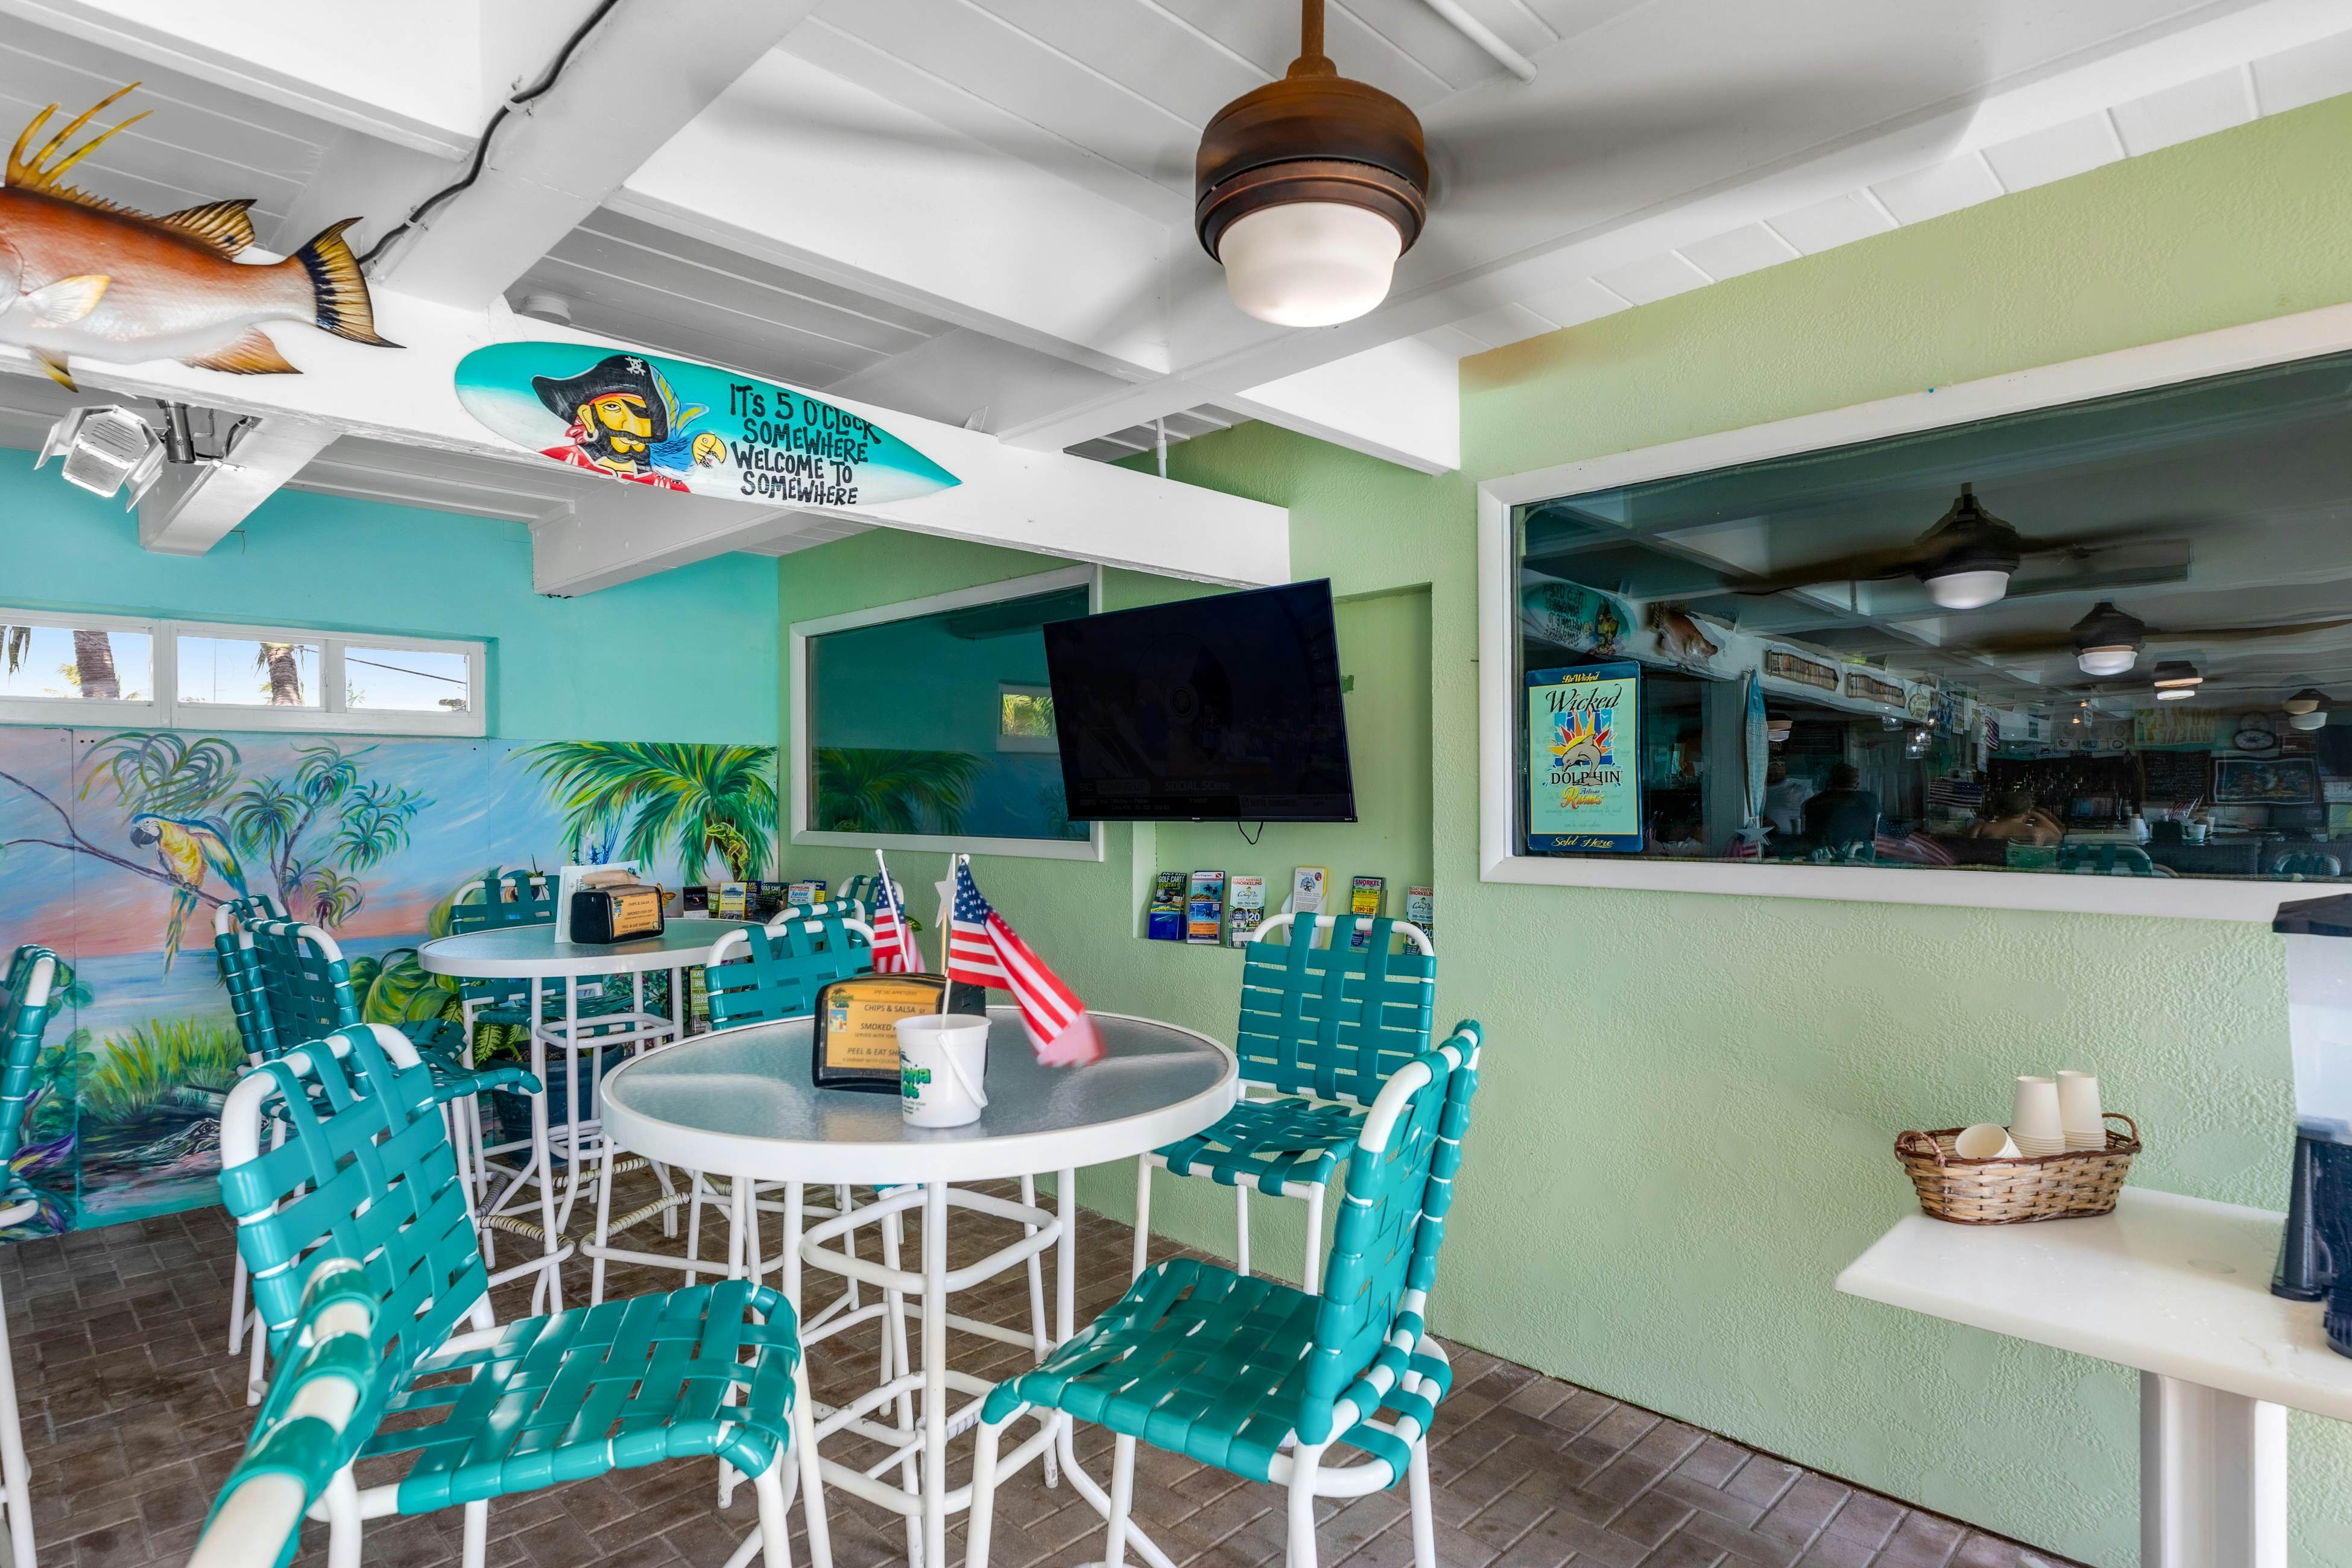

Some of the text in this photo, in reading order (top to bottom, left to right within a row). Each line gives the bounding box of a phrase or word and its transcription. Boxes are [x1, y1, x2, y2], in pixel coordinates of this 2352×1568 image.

[730, 383, 882, 444] IT'S 5 O'CLOCK
[742, 418, 868, 465] SOMEWHERE
[730, 441, 852, 487] WELCOME TO
[741, 470, 858, 505] SOMEWHERE
[1545, 683, 1622, 713] Wicked
[1551, 771, 1621, 785] DOLPHIN
[1560, 787, 1605, 810] Rums
[1551, 835, 1615, 848] Sold Here
[1424, 929, 1433, 938] 20
[864, 1004, 885, 1013] CHIPS
[894, 1005, 915, 1013] SALSA
[861, 1023, 891, 1031] SMOKED
